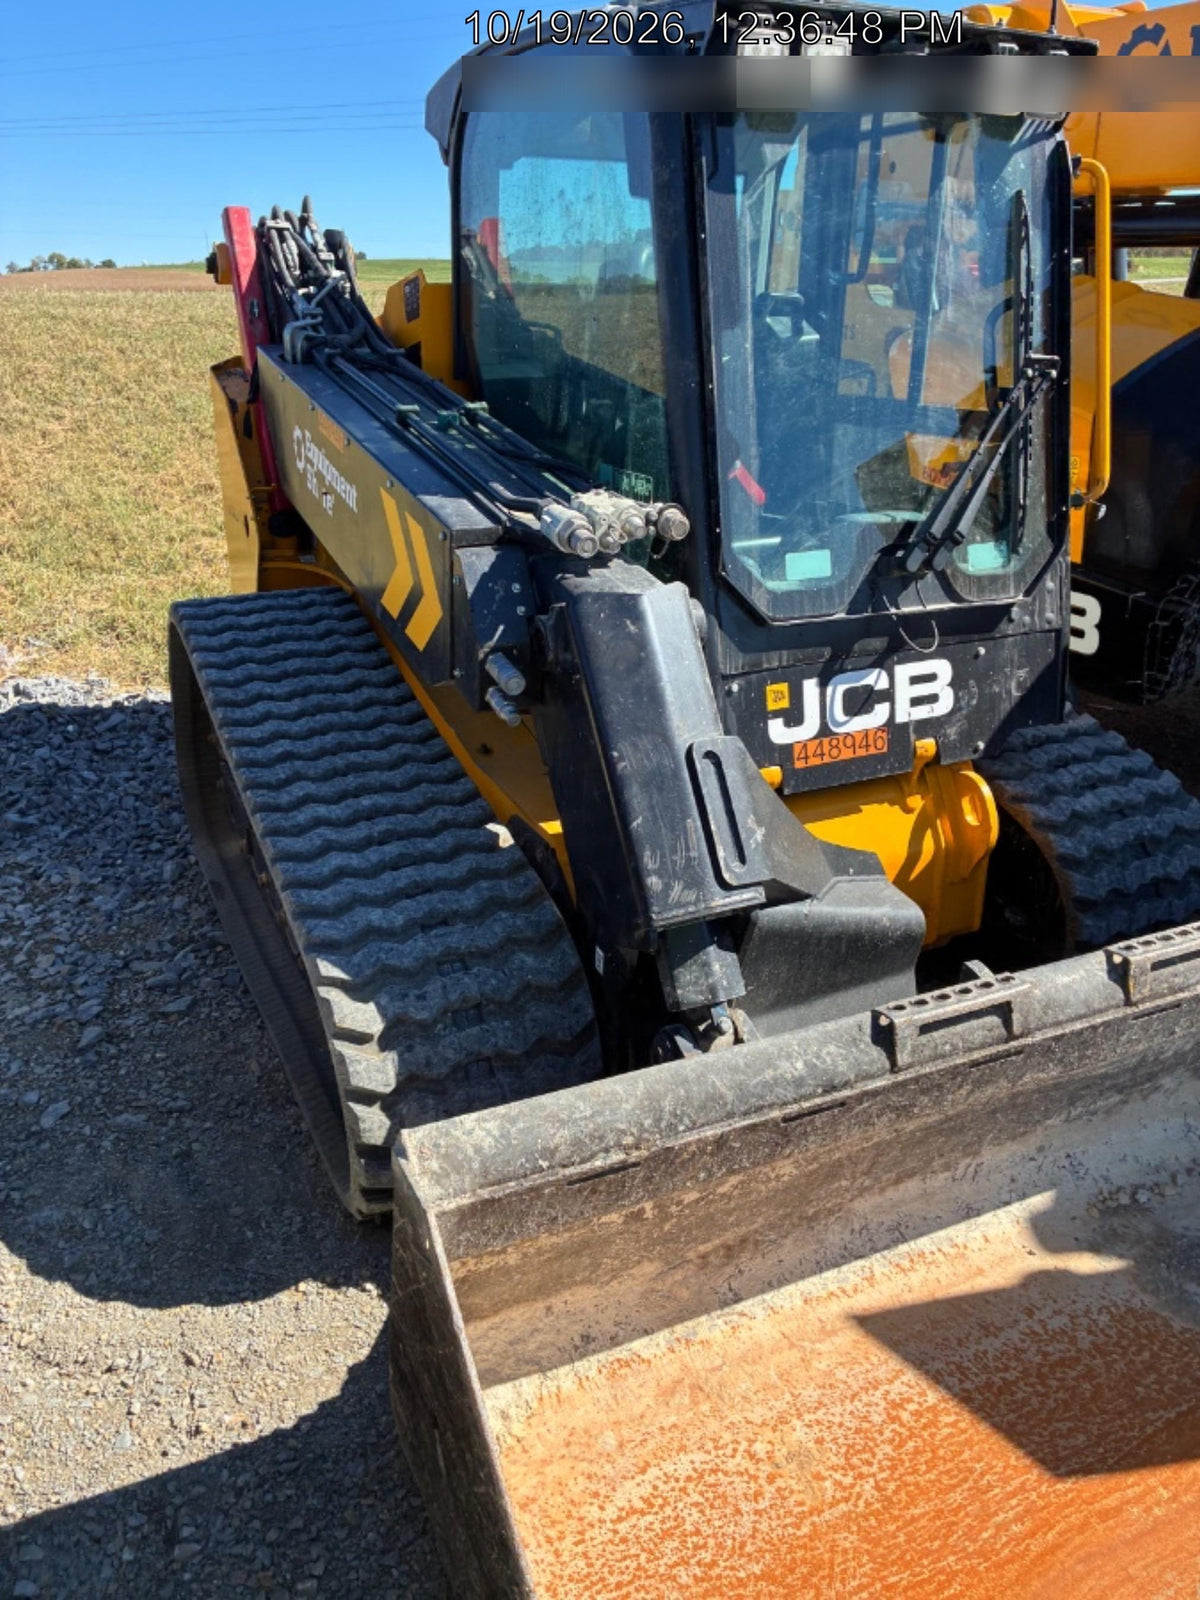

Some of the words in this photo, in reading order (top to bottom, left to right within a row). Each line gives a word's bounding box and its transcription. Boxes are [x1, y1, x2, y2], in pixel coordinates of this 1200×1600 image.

[305, 428, 358, 513] Equipment
[767, 658, 954, 745] JCB
[796, 727, 886, 766] 448946
